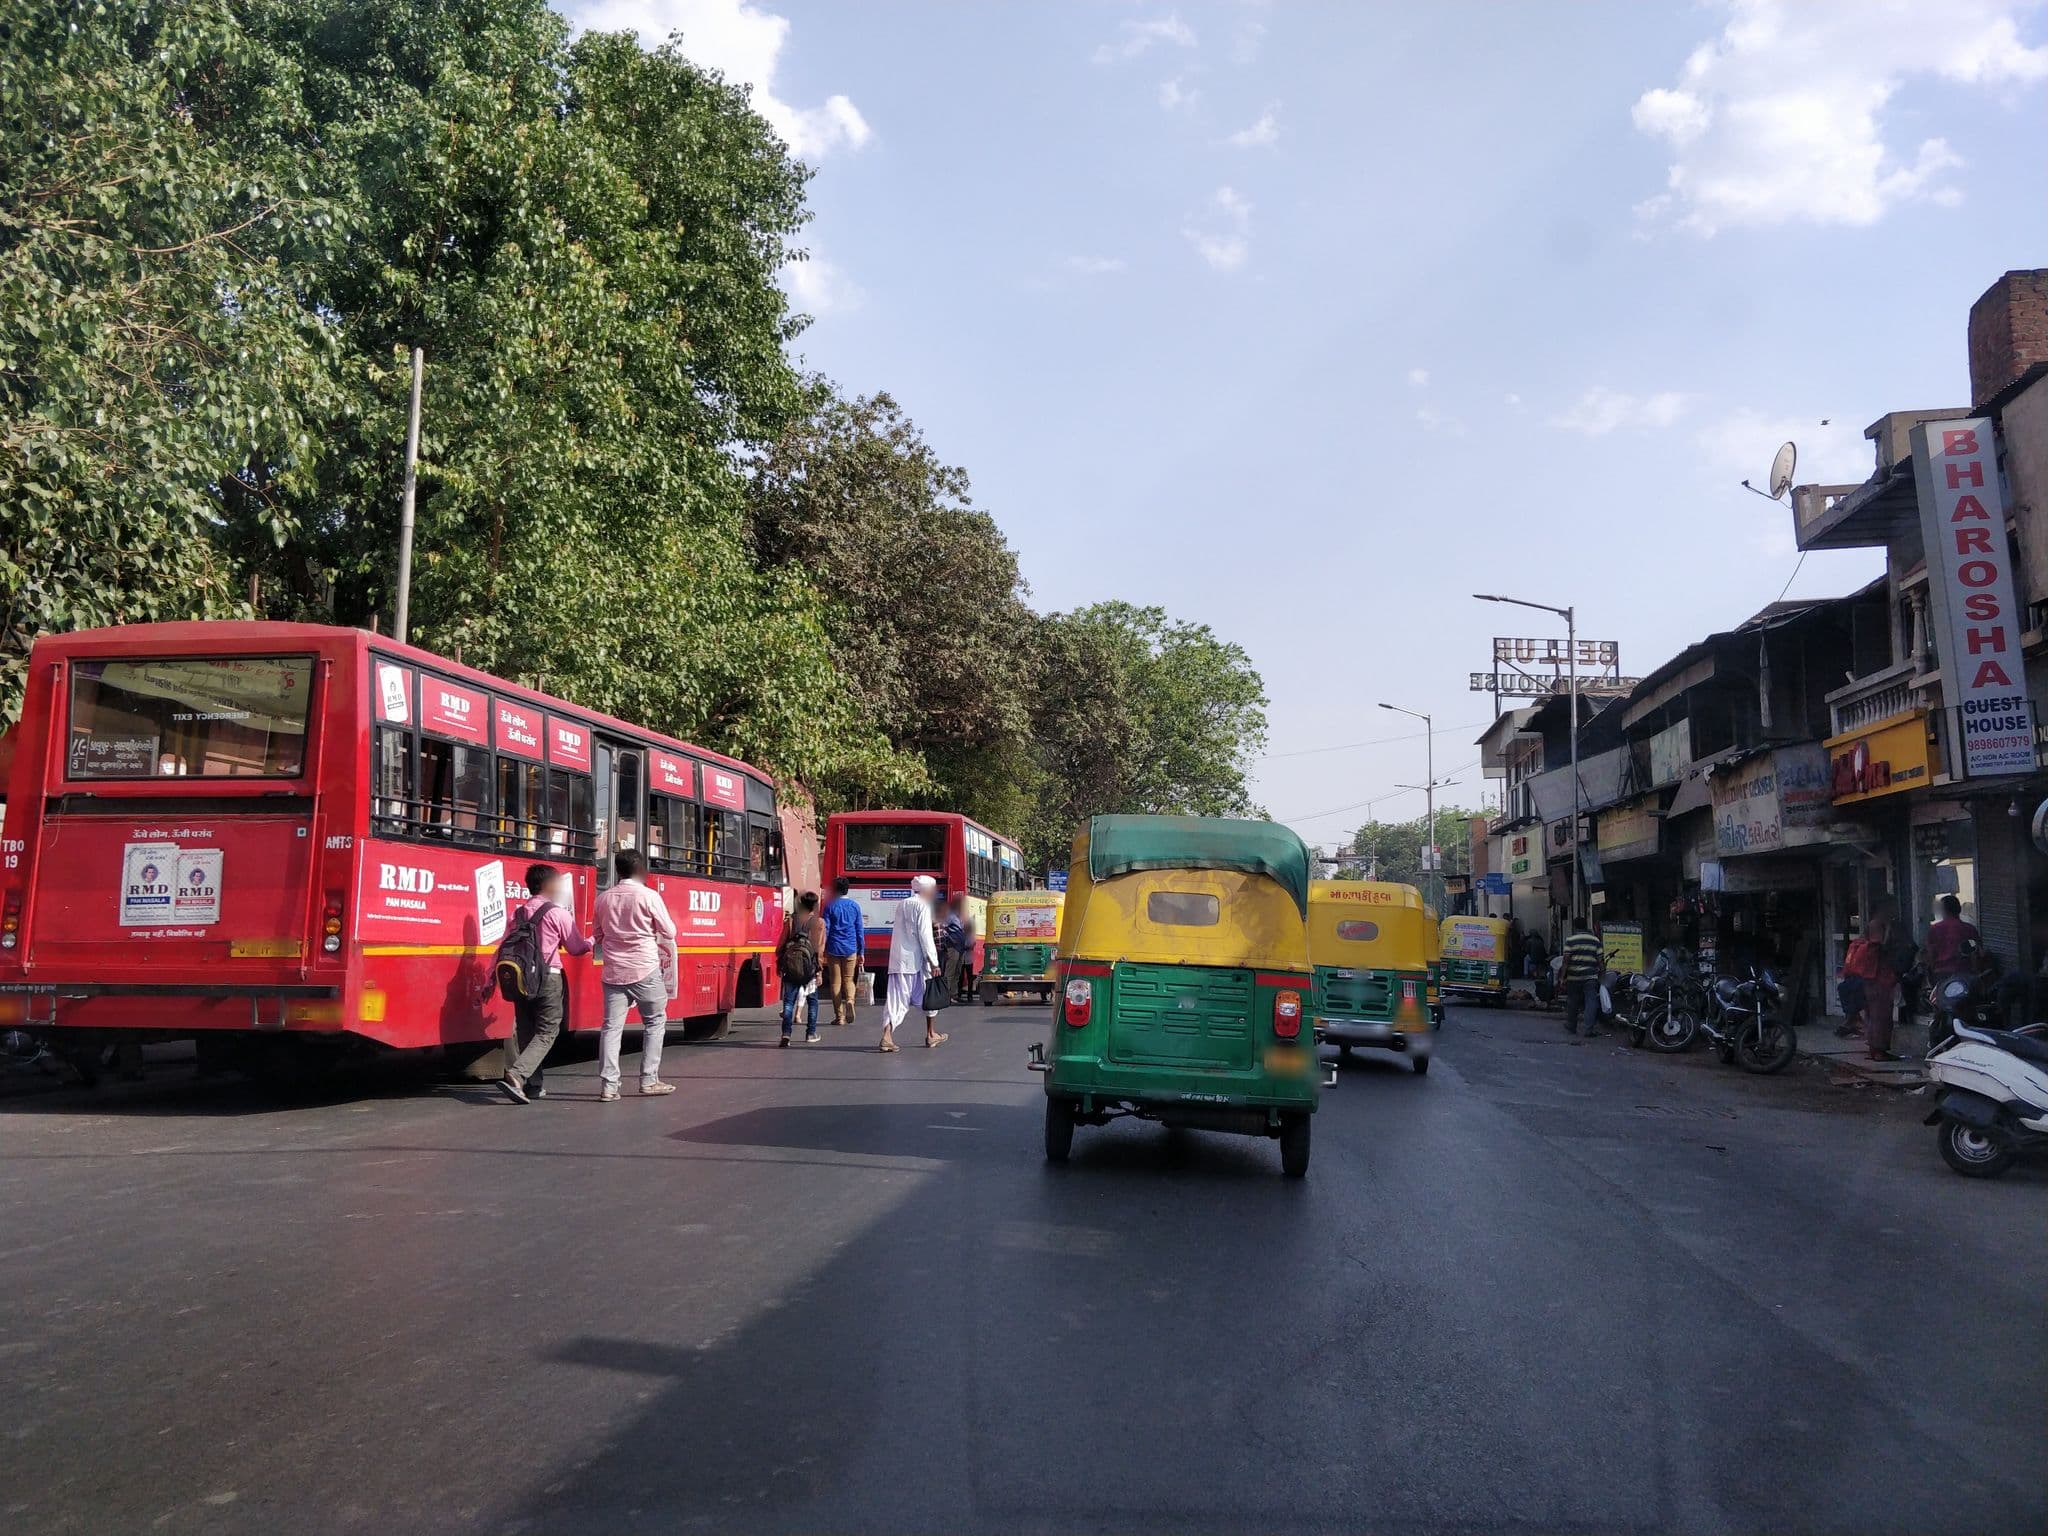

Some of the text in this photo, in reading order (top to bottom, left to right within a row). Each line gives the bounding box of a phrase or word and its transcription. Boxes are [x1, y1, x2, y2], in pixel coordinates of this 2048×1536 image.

[1942, 429, 2012, 688] BHAROSHA
[440, 691, 470, 713] RMD
[1964, 696, 2022, 714] GUEST
[1966, 715, 2027, 734] HOUSE
[1968, 736, 2030, 751] 9898607979
[325, 836, 353, 849] AMTS
[5, 855, 18, 868] 19
[379, 863, 434, 894] RMD
[129, 884, 169, 895] RMD
[179, 887, 214, 896] RMD
[385, 896, 427, 910] PAN MASALA
[482, 900, 502, 916] RMD
[688, 890, 721, 912] RMD
